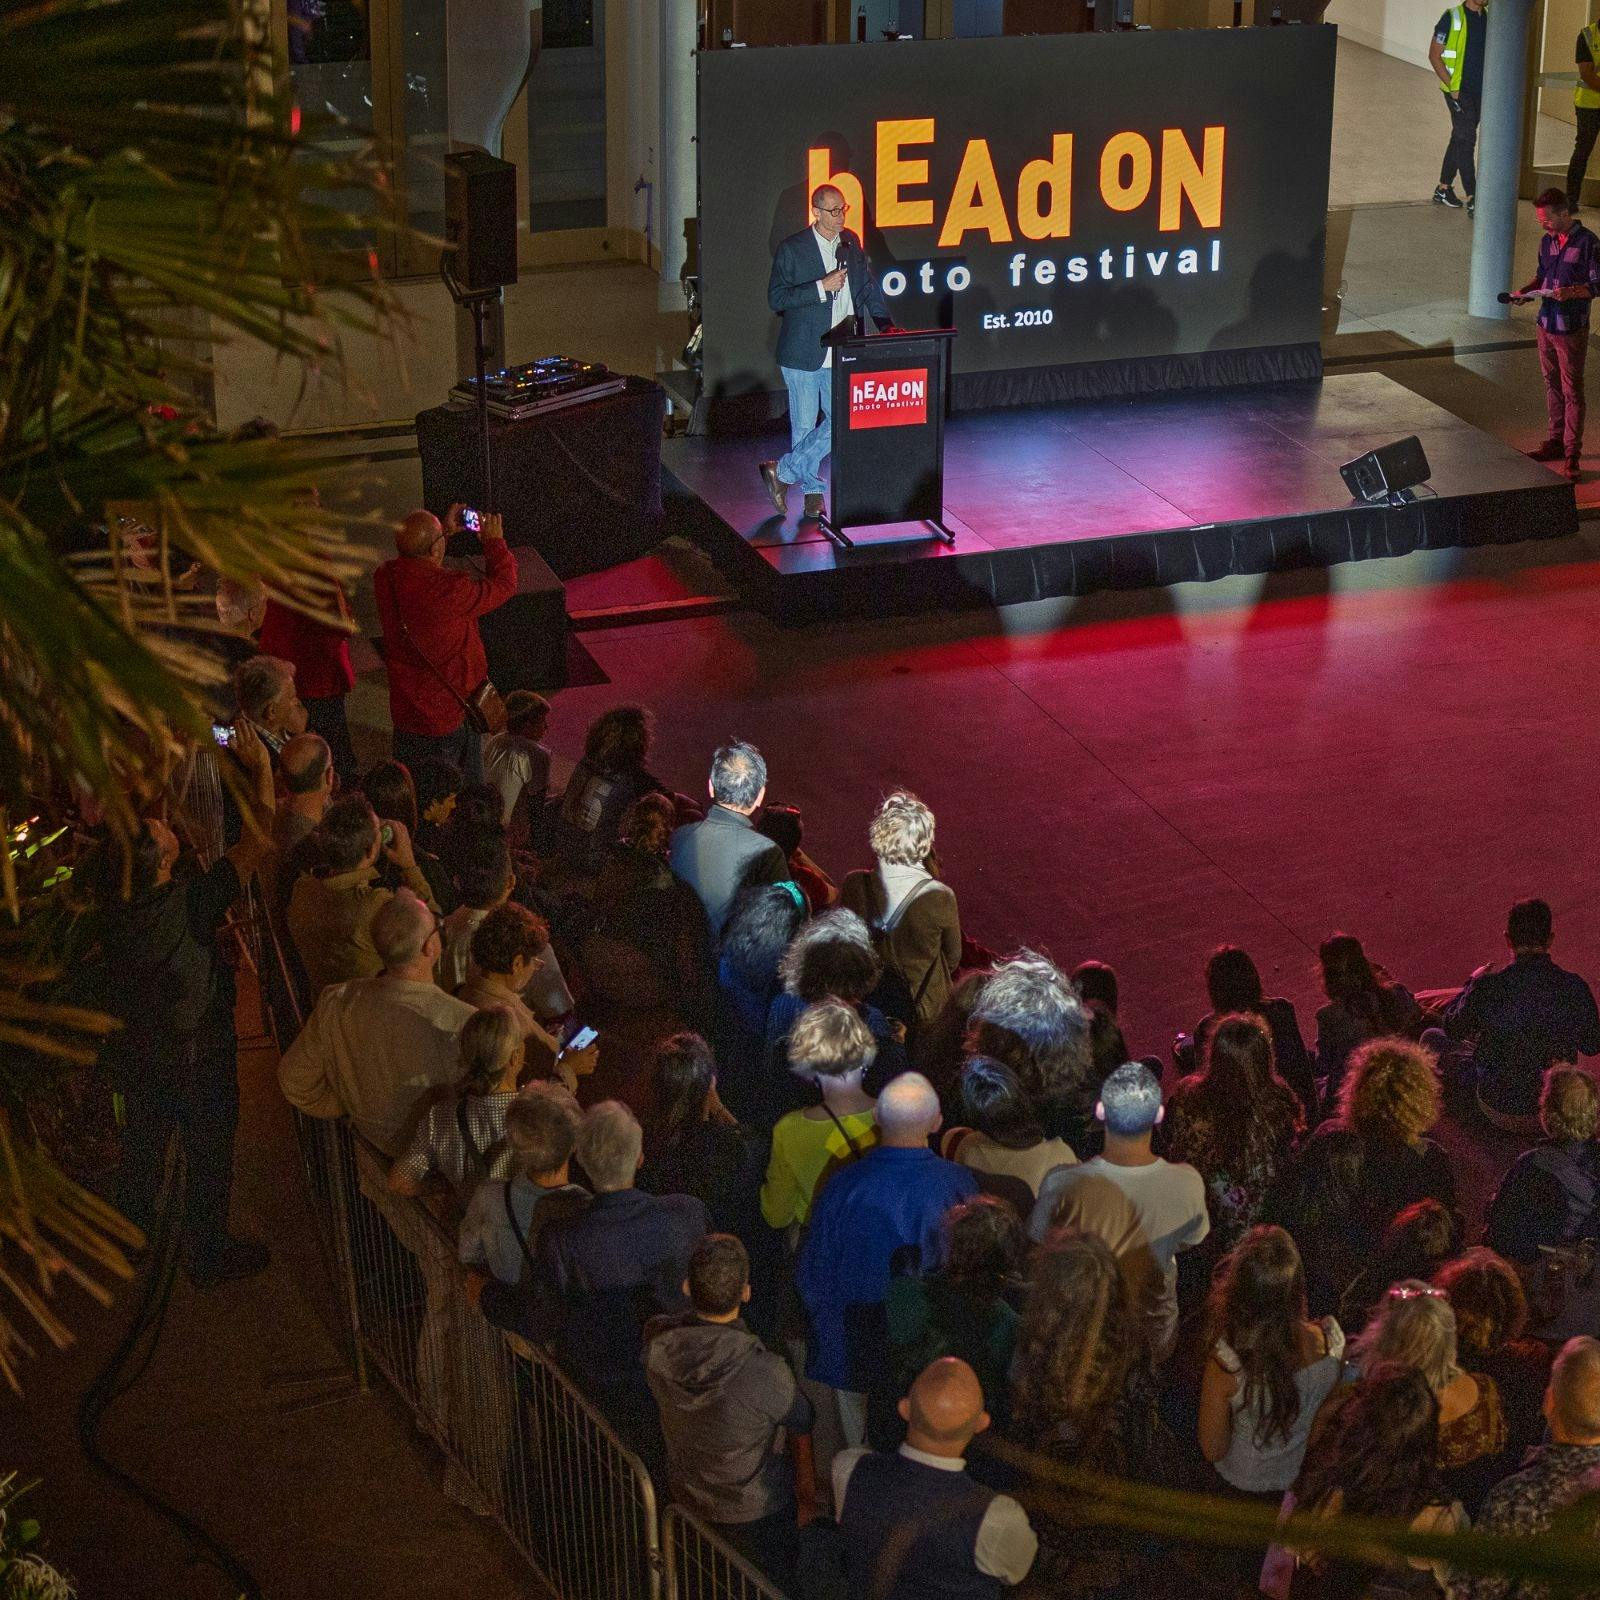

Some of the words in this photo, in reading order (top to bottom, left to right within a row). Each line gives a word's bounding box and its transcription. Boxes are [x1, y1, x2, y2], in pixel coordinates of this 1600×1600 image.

[1099, 126, 1226, 232] ON
[882, 262, 971, 296] oto
[1009, 240, 1221, 287] festival
[983, 314, 1010, 329] Est.
[1014, 309, 1053, 327] 2010
[853, 381, 897, 403] hEAd
[901, 380, 924, 398] ON
[852, 404, 881, 412] photo
[886, 399, 924, 408] festival
